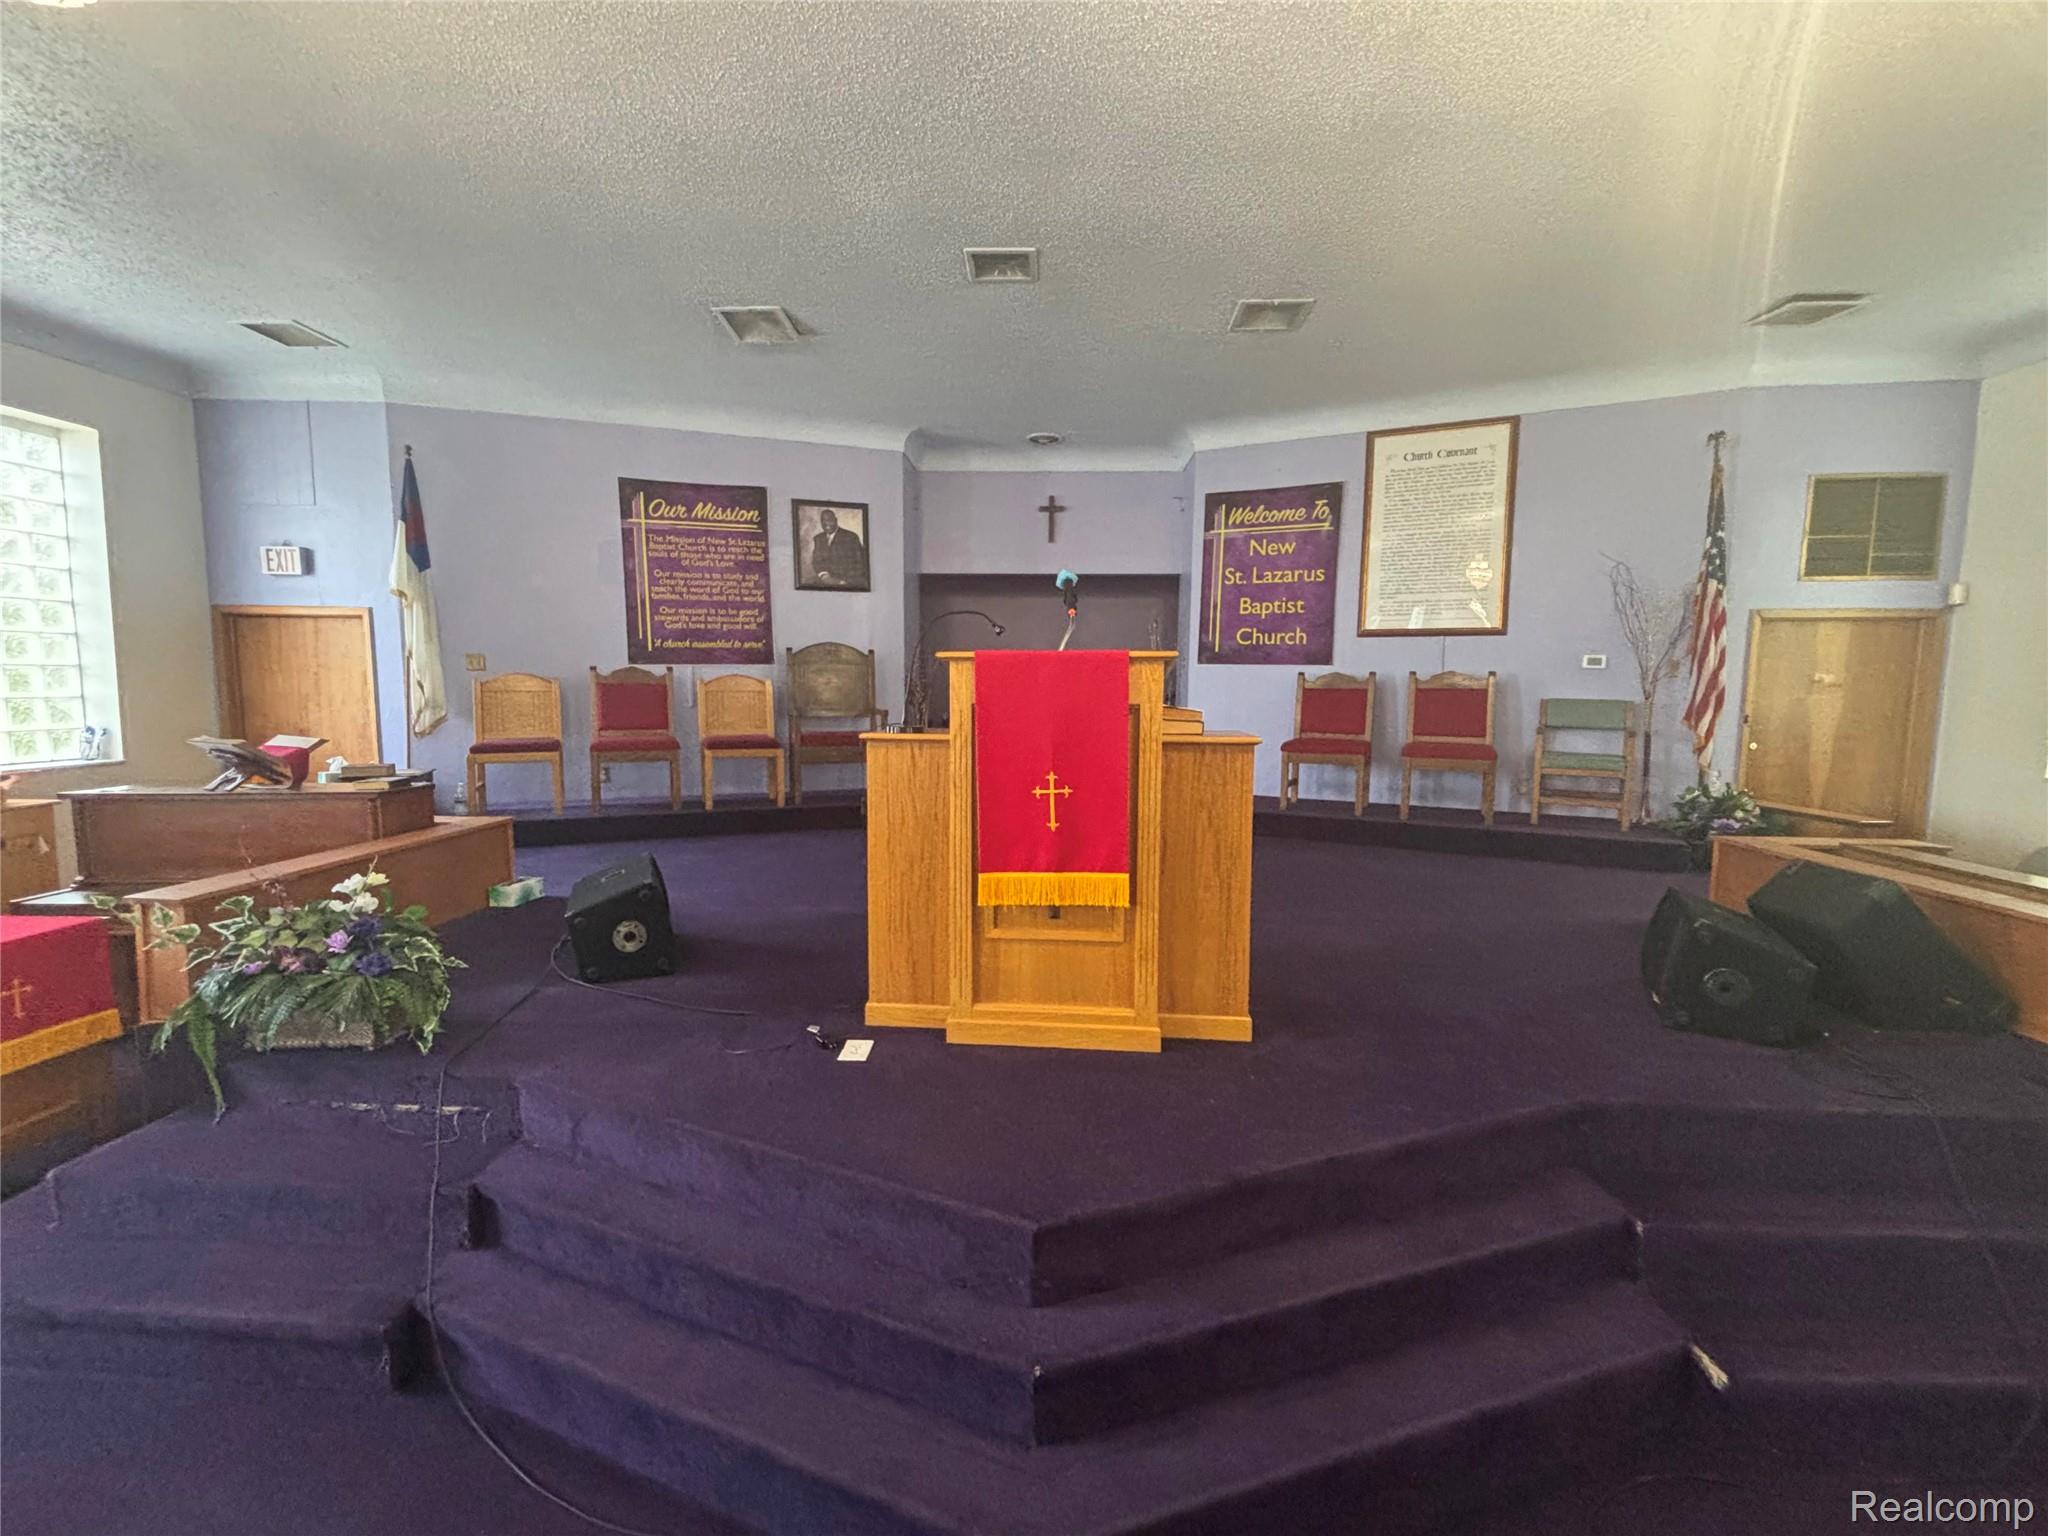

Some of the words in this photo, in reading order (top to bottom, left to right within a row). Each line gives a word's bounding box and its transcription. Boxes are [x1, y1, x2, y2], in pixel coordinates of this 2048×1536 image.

[1403, 451, 1433, 462] Church
[649, 499, 687, 518] Our
[691, 502, 760, 522] Mission
[1228, 505, 1307, 526] Welcome
[1312, 500, 1330, 520] To
[678, 543, 707, 552] Church
[1250, 539, 1296, 557] New
[265, 548, 297, 573] EXIT
[654, 569, 670, 578] Our
[1224, 568, 1247, 585] St.
[1252, 567, 1325, 584] Lazarus
[660, 605, 677, 615] Our
[1240, 598, 1305, 619] Baptist
[1236, 627, 1307, 645] Church
